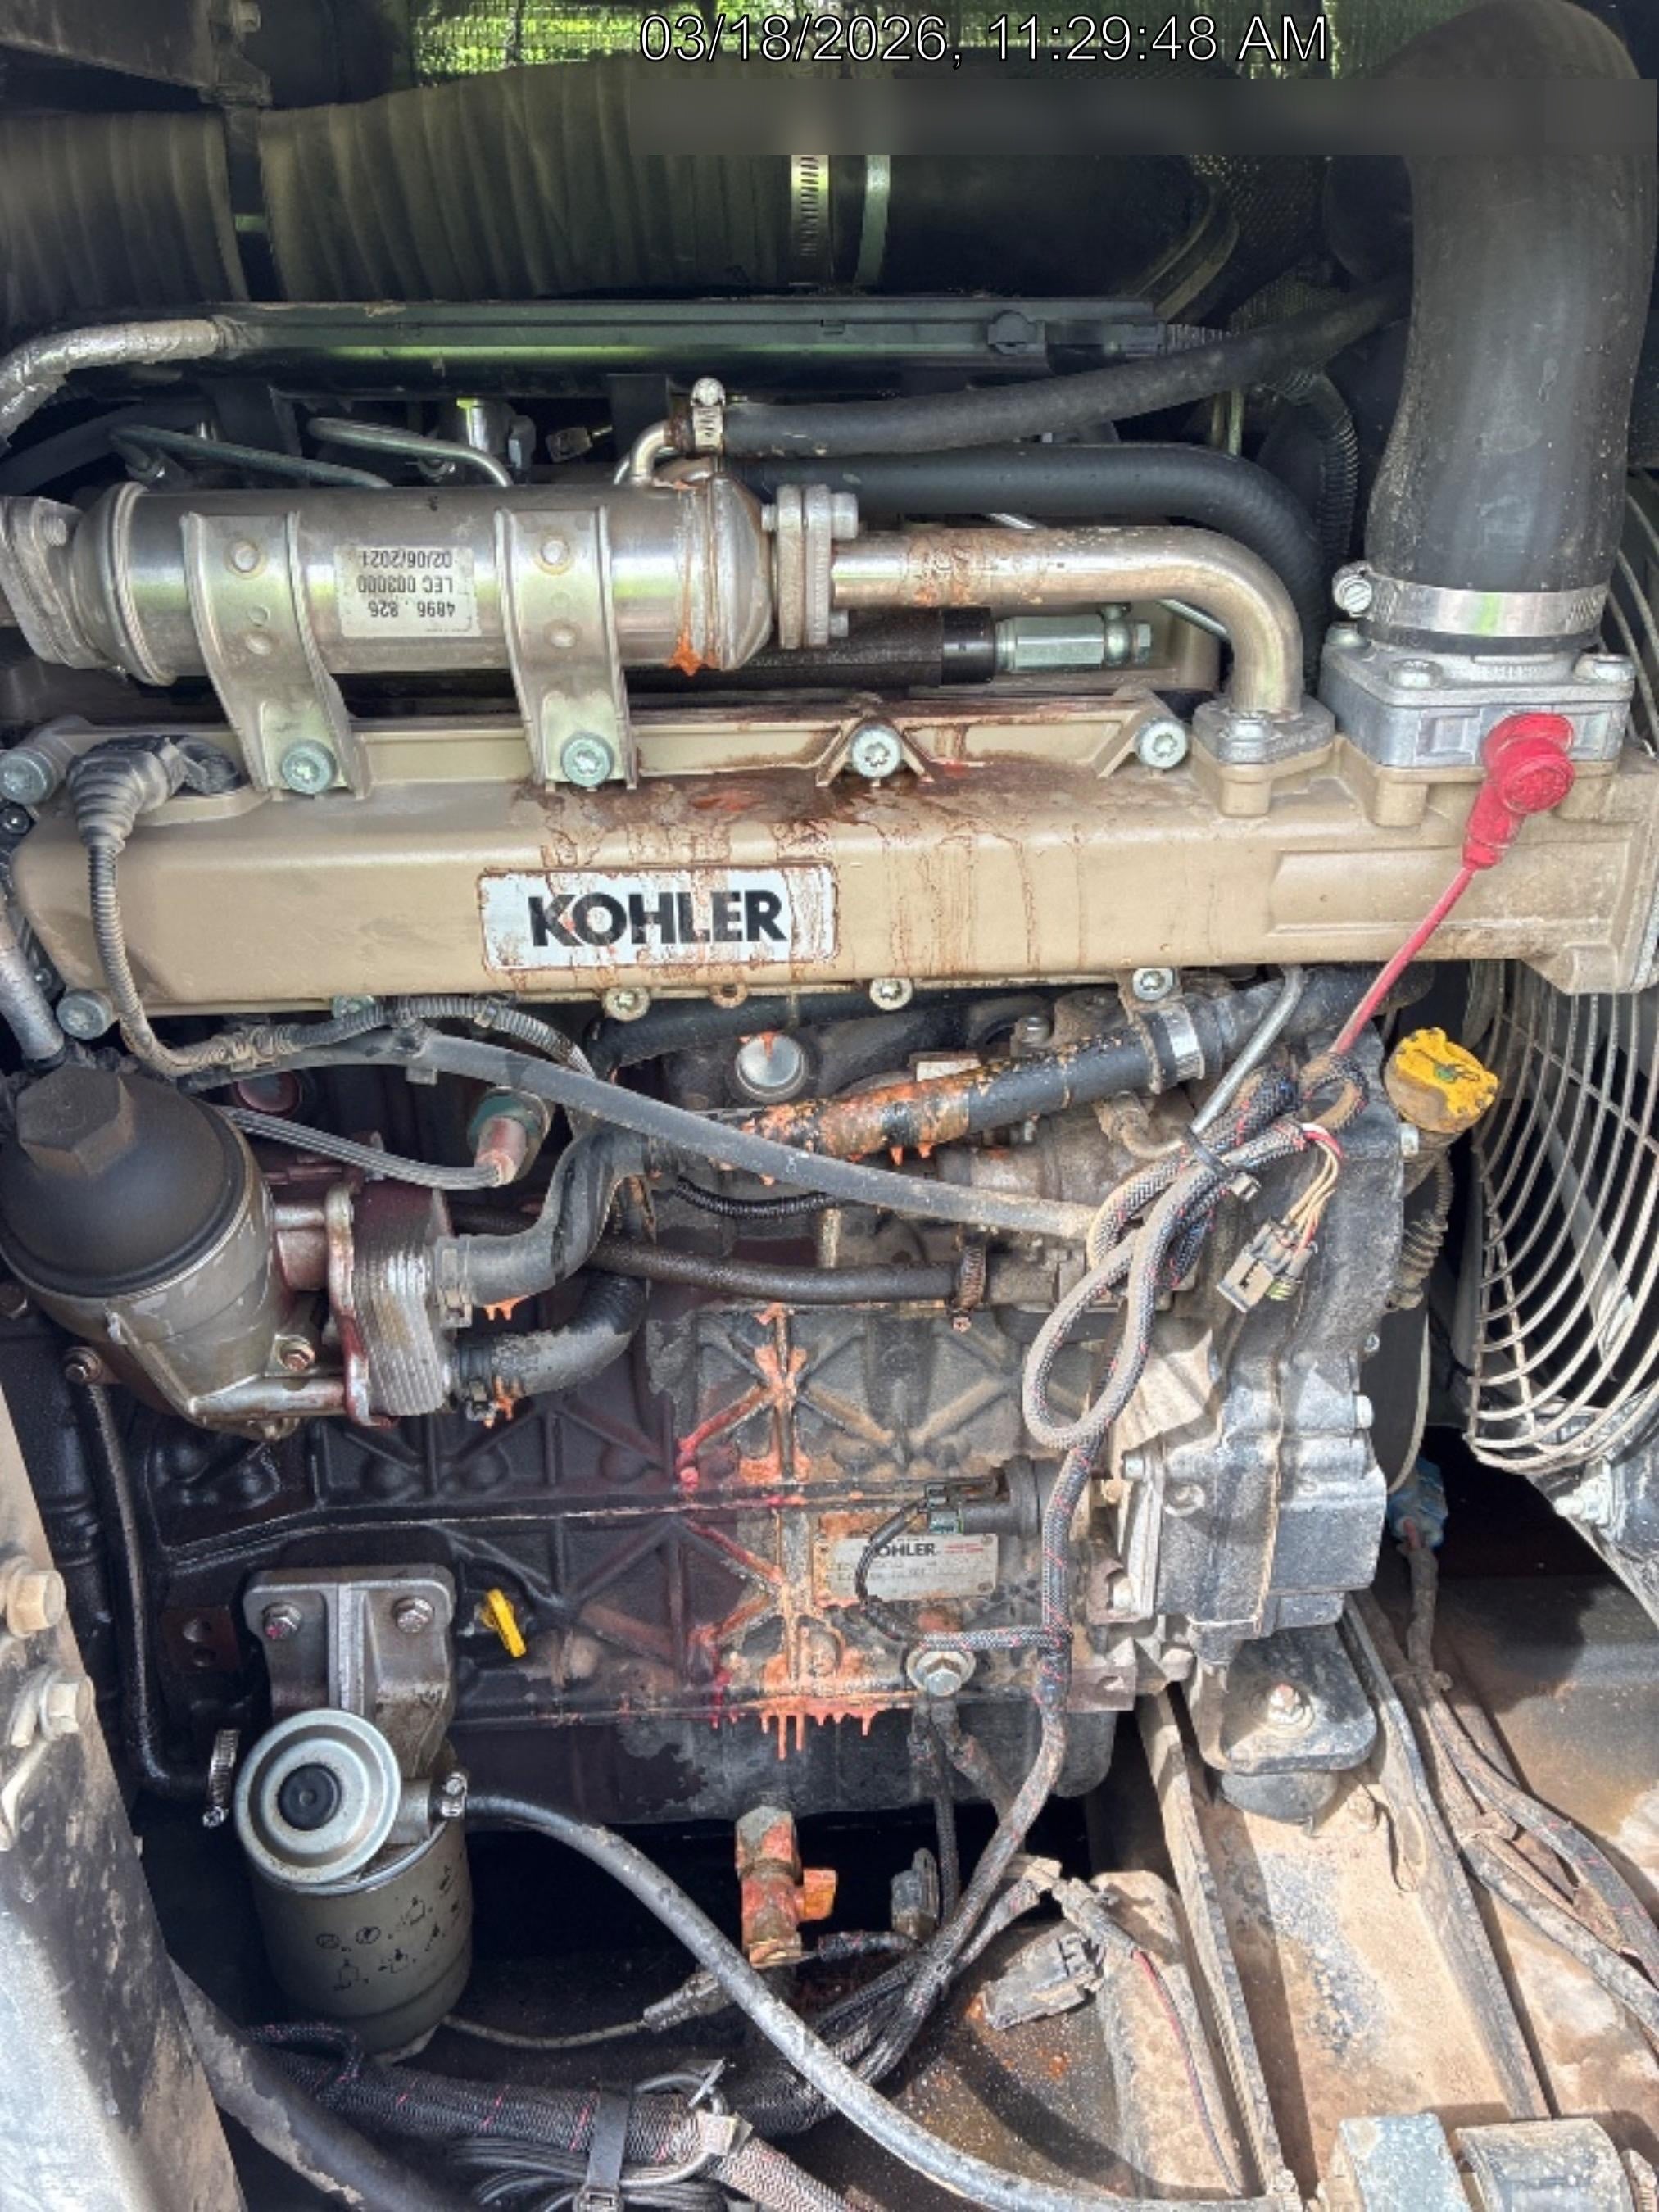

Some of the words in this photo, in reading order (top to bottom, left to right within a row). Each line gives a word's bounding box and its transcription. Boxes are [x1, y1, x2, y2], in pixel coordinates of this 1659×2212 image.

[363, 551, 452, 569] 02/06/2021
[423, 576, 453, 593] LEC
[417, 601, 456, 618] 4896
[528, 890, 787, 947] KOHLER
